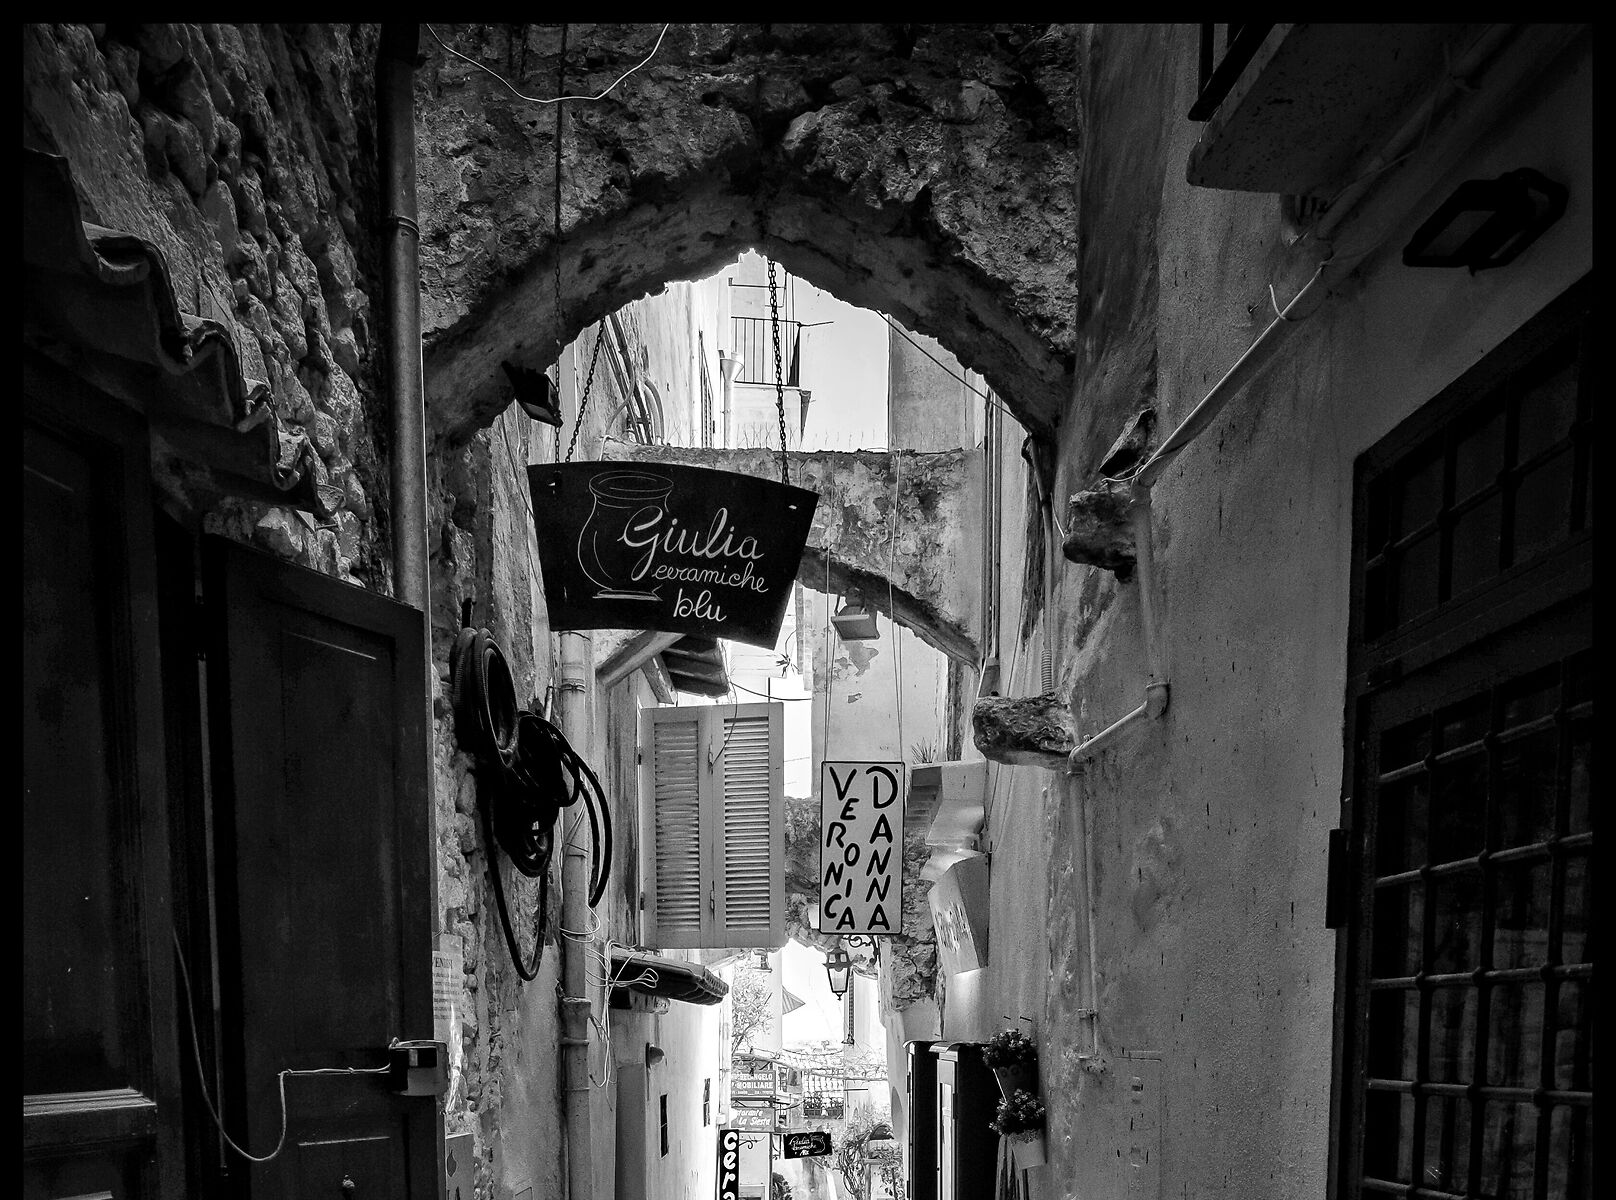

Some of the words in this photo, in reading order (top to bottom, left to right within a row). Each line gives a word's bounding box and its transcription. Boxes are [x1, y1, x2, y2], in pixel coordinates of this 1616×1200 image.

[617, 505, 765, 582] Giulia
[652, 562, 769, 593] ceramiche
[672, 588, 727, 622] blu
[865, 765, 899, 931] DANNA
